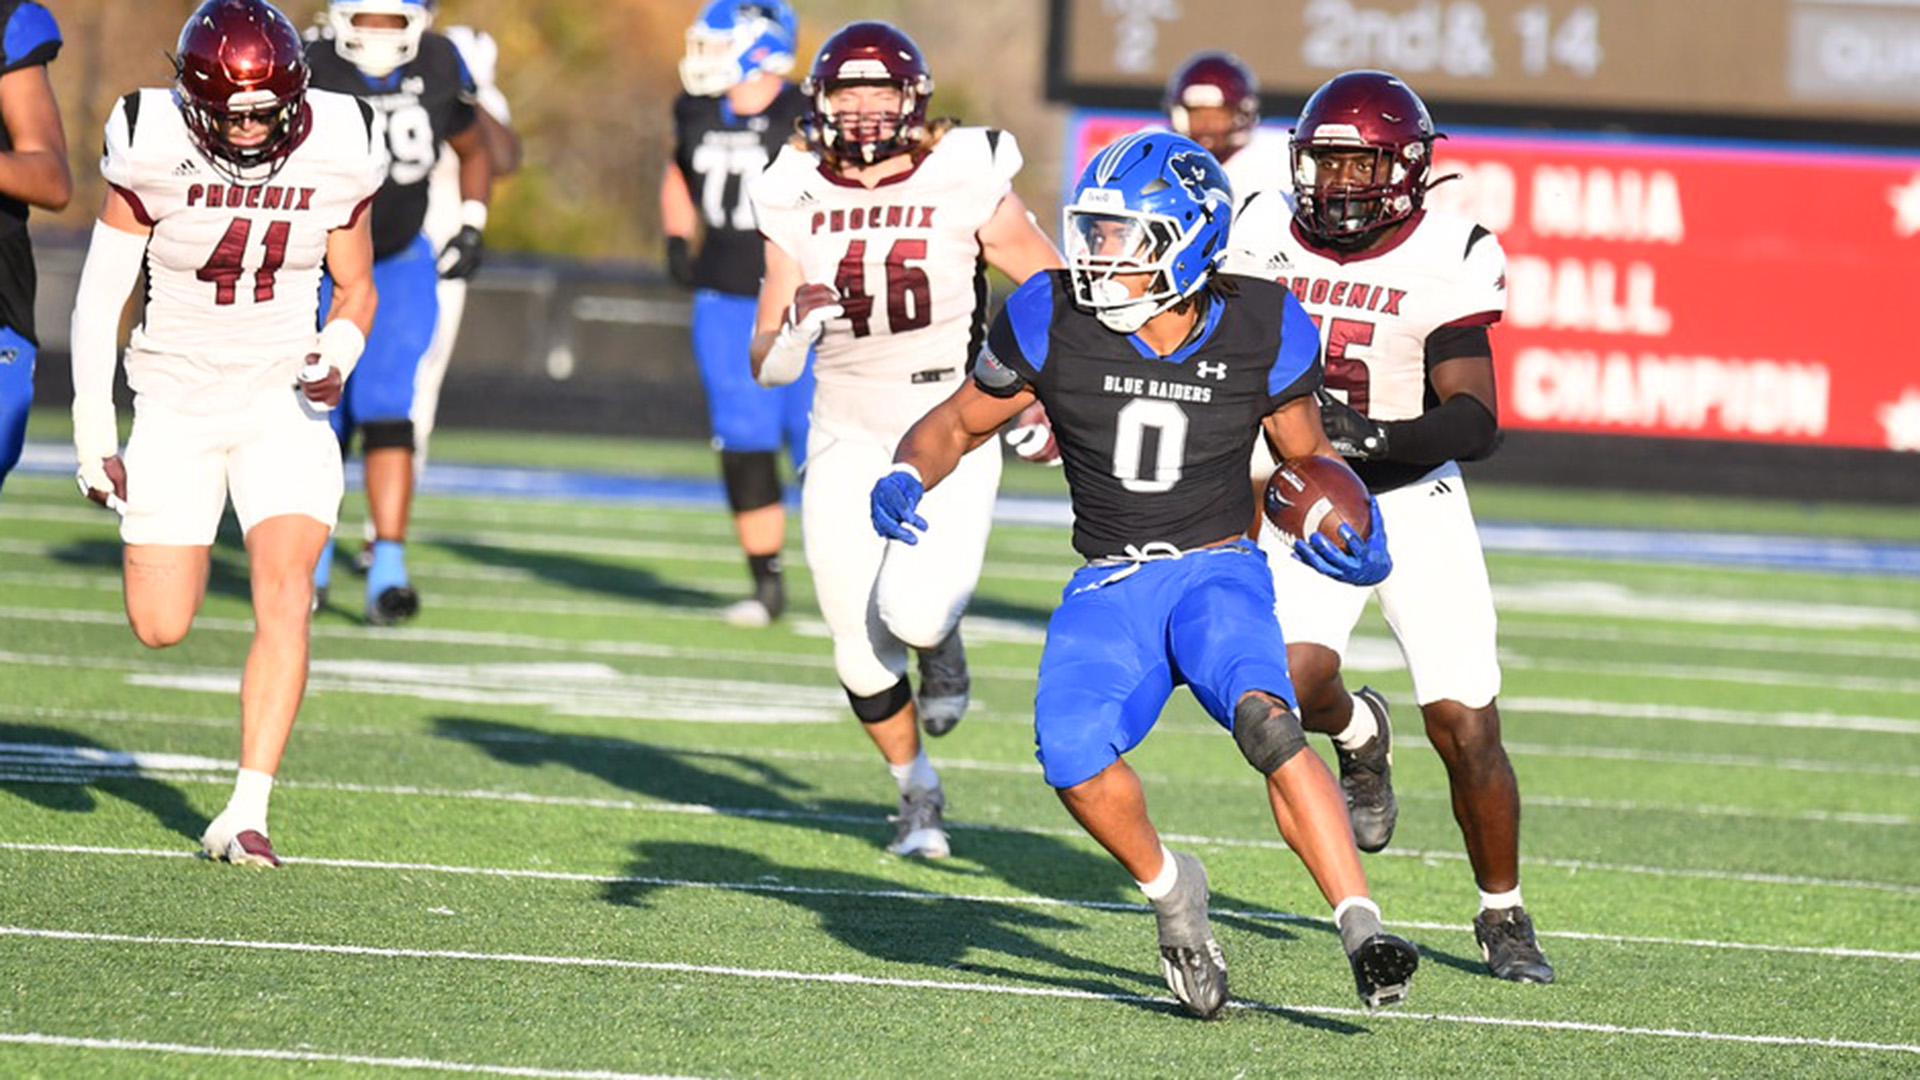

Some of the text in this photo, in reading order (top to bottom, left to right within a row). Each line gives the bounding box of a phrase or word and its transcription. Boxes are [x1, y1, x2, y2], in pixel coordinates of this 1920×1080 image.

[1514, 4, 1603, 77] 14
[374, 104, 435, 185] 9
[187, 183, 316, 211] PHOENIX
[692, 144, 769, 230] 77
[811, 205, 937, 235] PHOENIX
[1530, 164, 1686, 245] NAIA
[196, 216, 291, 305] 41
[834, 238, 932, 338] 46
[1104, 375, 1212, 403] BLUE RAIDERS
[1310, 313, 1376, 420] 5
[1513, 346, 1831, 438] CHAMPION
[1112, 397, 1189, 493] 0
